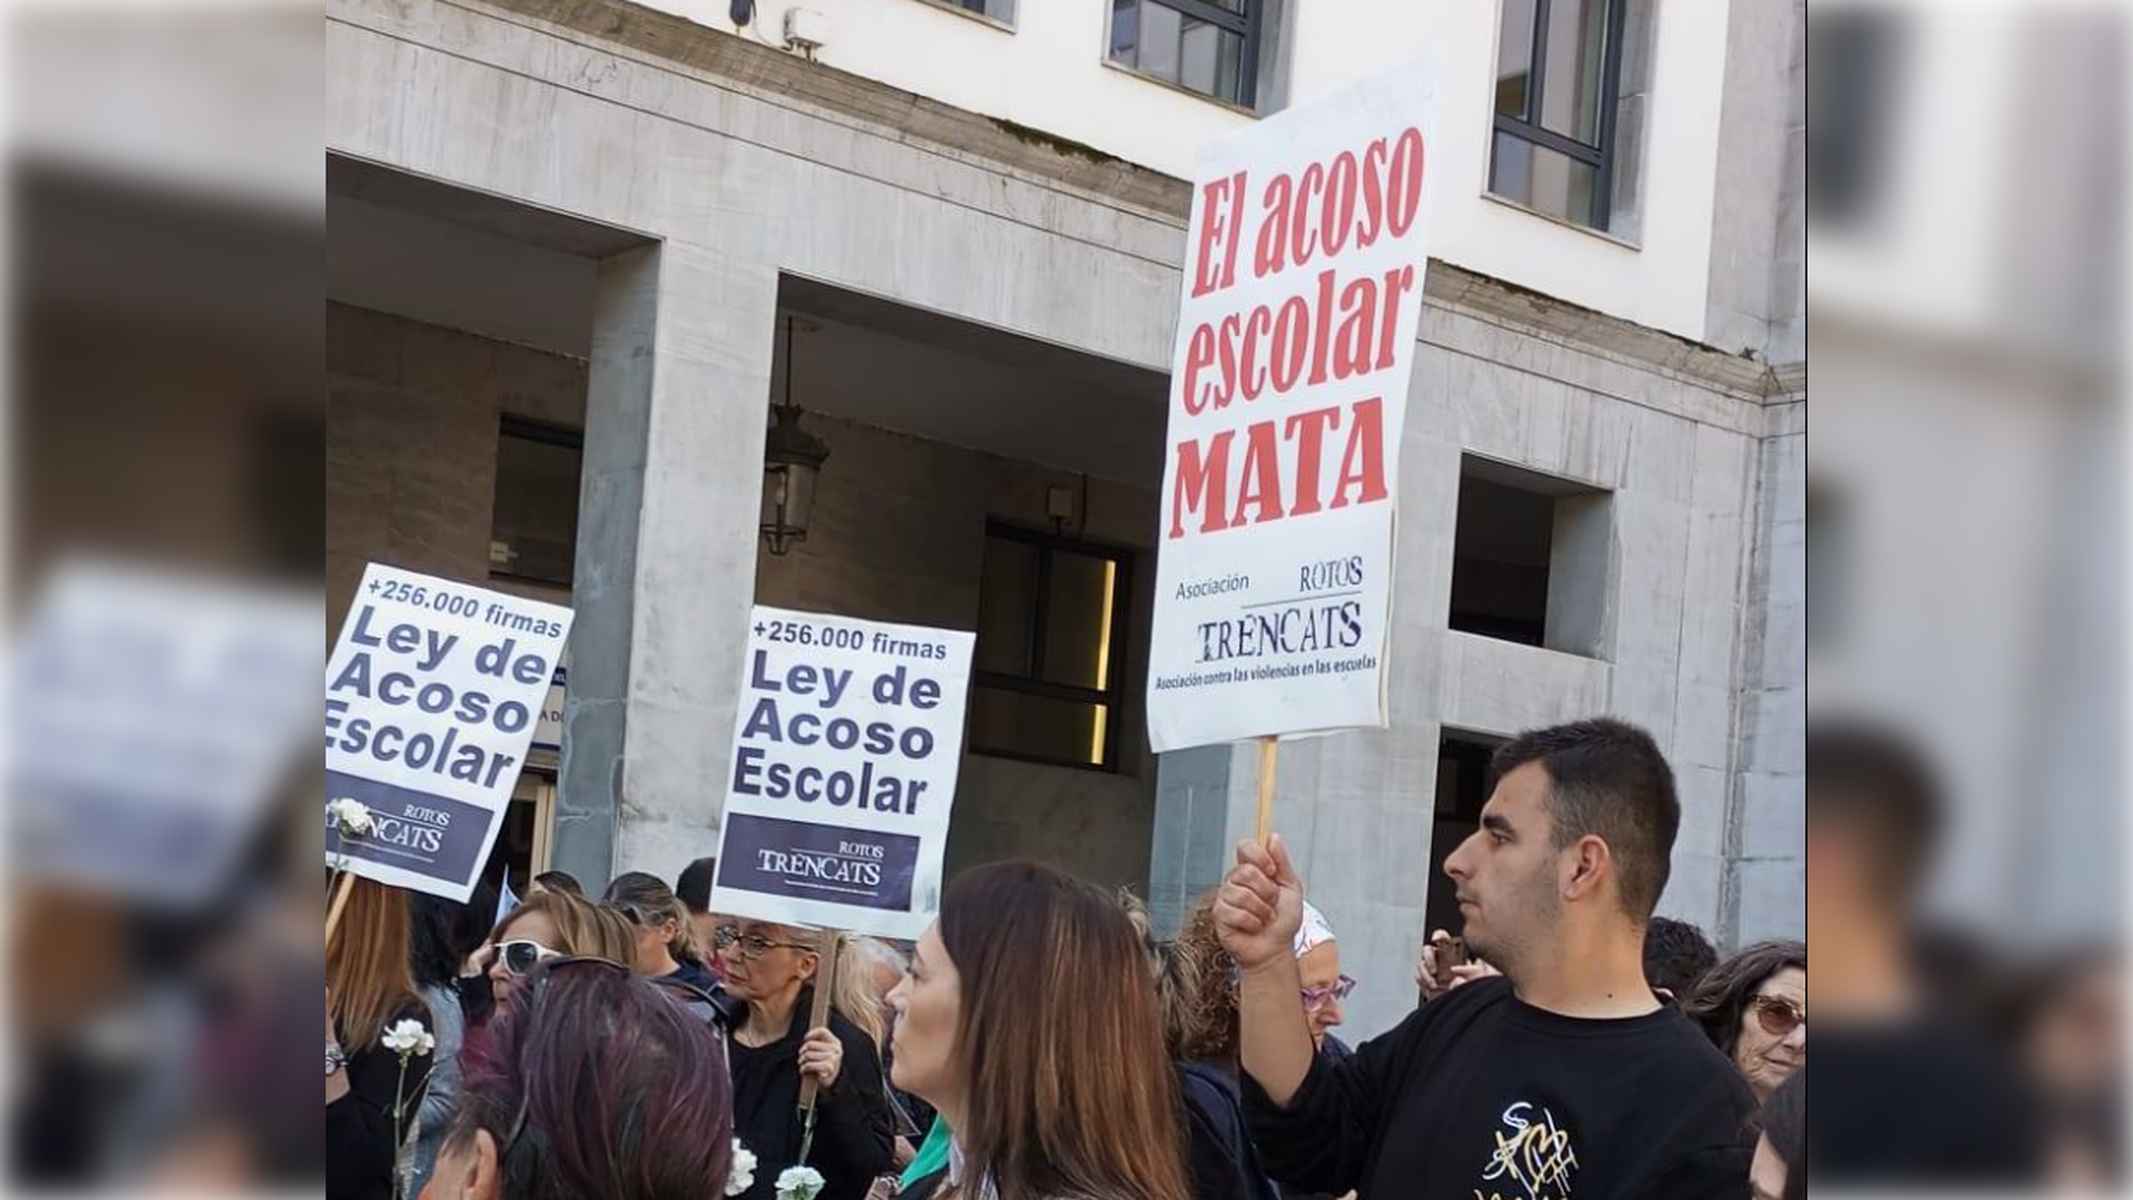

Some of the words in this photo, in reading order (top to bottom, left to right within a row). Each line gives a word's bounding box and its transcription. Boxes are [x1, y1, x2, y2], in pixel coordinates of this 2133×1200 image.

[1191, 171, 1248, 298] El
[1254, 127, 1425, 278] acoso
[1182, 265, 1414, 416] escolar
[1169, 397, 1388, 539] MATA
[1175, 574, 1250, 600] Asociación
[1299, 555, 1363, 593] ROTOS
[368, 579, 479, 619] +256.000
[484, 603, 562, 638] firmas
[1195, 601, 1362, 663] TRENCATS
[350, 605, 459, 671] Ley
[474, 638, 547, 685] de
[754, 620, 864, 650] +256.000
[872, 633, 947, 660] firmas
[329, 652, 530, 734] Acoso
[751, 649, 853, 709] Ley
[872, 665, 941, 709] de
[1155, 673, 1202, 690] Asociación
[1203, 671, 1232, 684] contra
[1234, 667, 1248, 682] las
[1250, 661, 1300, 681] violencias
[1302, 663, 1314, 676] en
[1315, 659, 1331, 673] las
[1333, 654, 1377, 671] escuelas
[741, 698, 934, 759] Acoso
[732, 746, 928, 815] Escolar
[403, 803, 451, 826] ROTOS
[757, 848, 881, 886] TRENCATS
[839, 840, 885, 859] ROTOS
